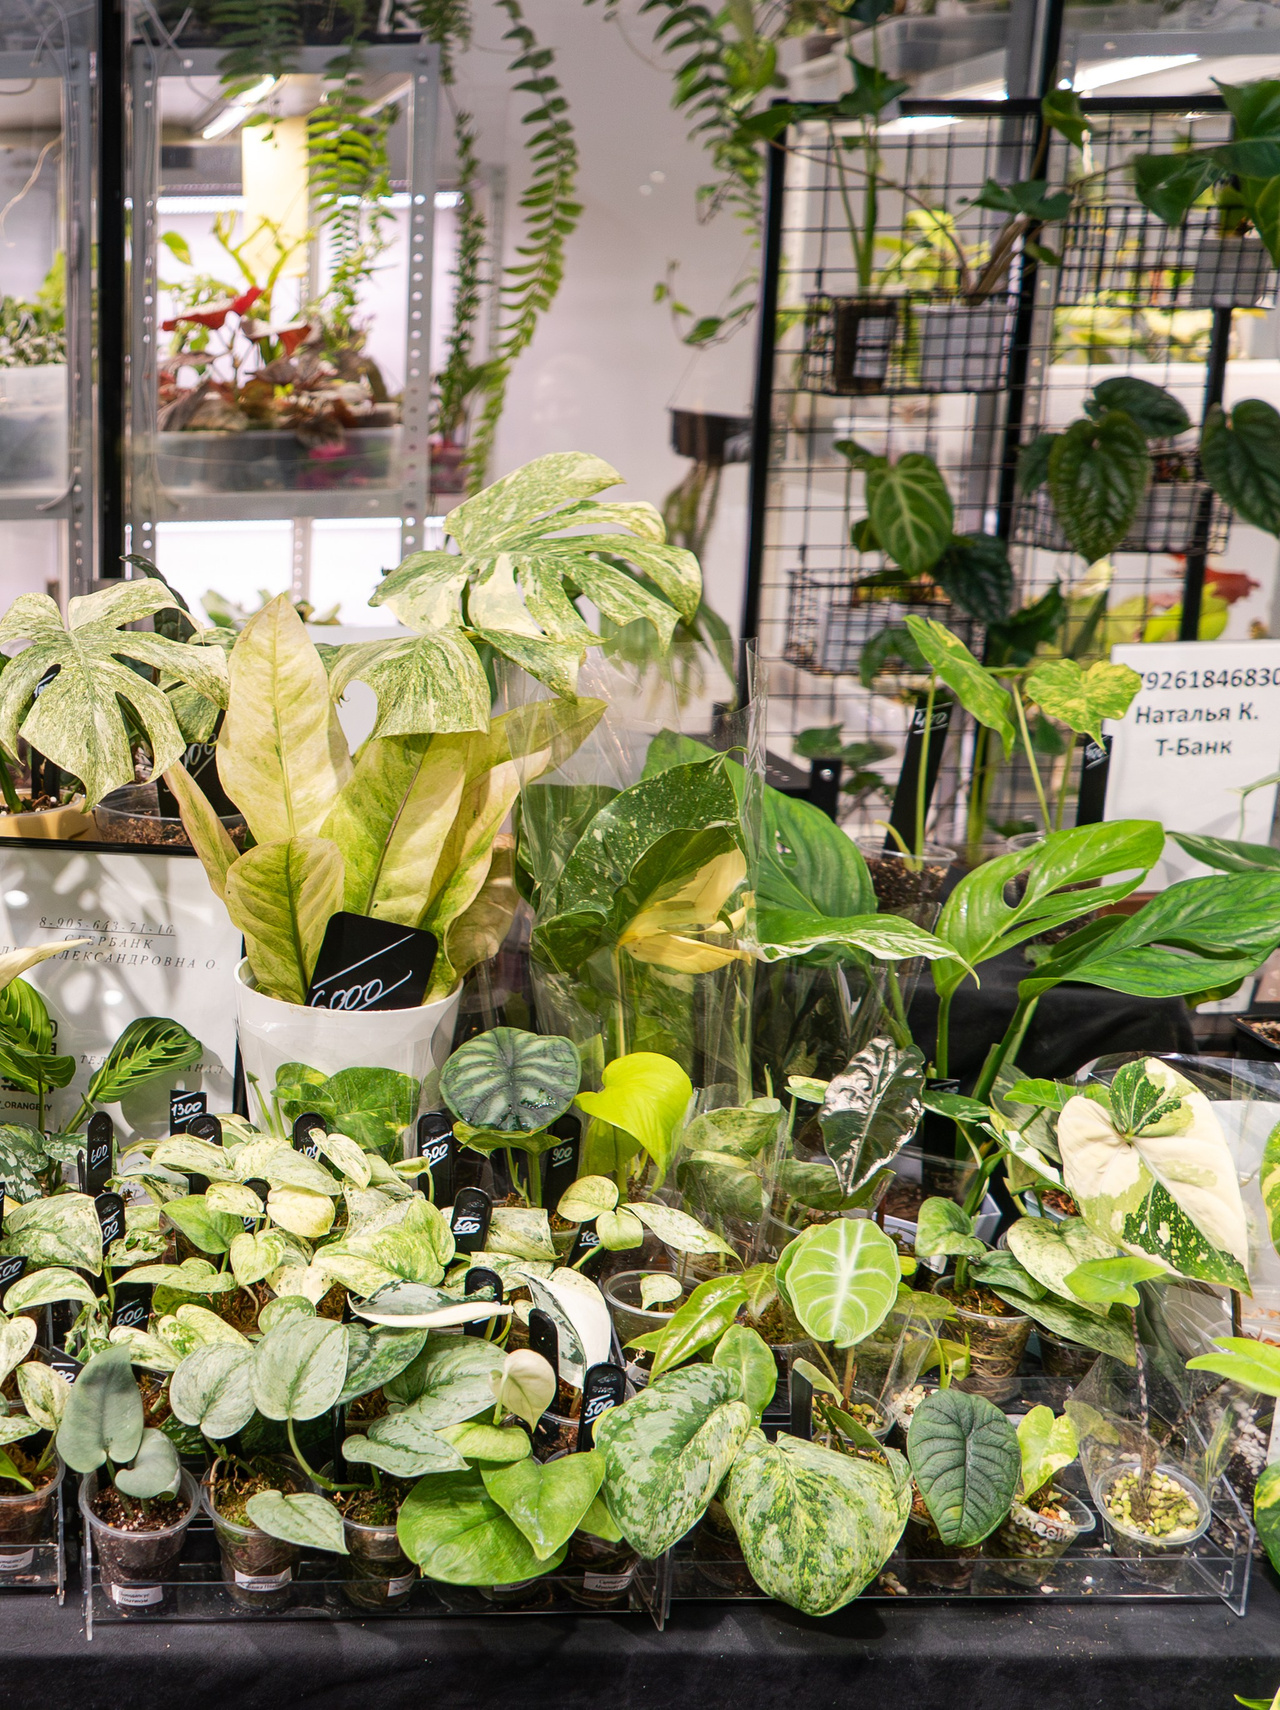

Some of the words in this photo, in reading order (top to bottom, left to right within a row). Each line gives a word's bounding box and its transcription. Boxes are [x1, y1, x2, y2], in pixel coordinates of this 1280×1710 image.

[1140, 668, 1280, 690] 9261846830
[1135, 706, 1231, 724] Наталья
[1239, 702, 1258, 720] К.
[1155, 738, 1232, 756] Т-Банк
[170, 1101, 203, 1117] 1300
[91, 1144, 109, 1164] 600
[552, 1146, 573, 1162] 900
[116, 1307, 145, 1326] 600
[584, 1399, 616, 1418] 500
